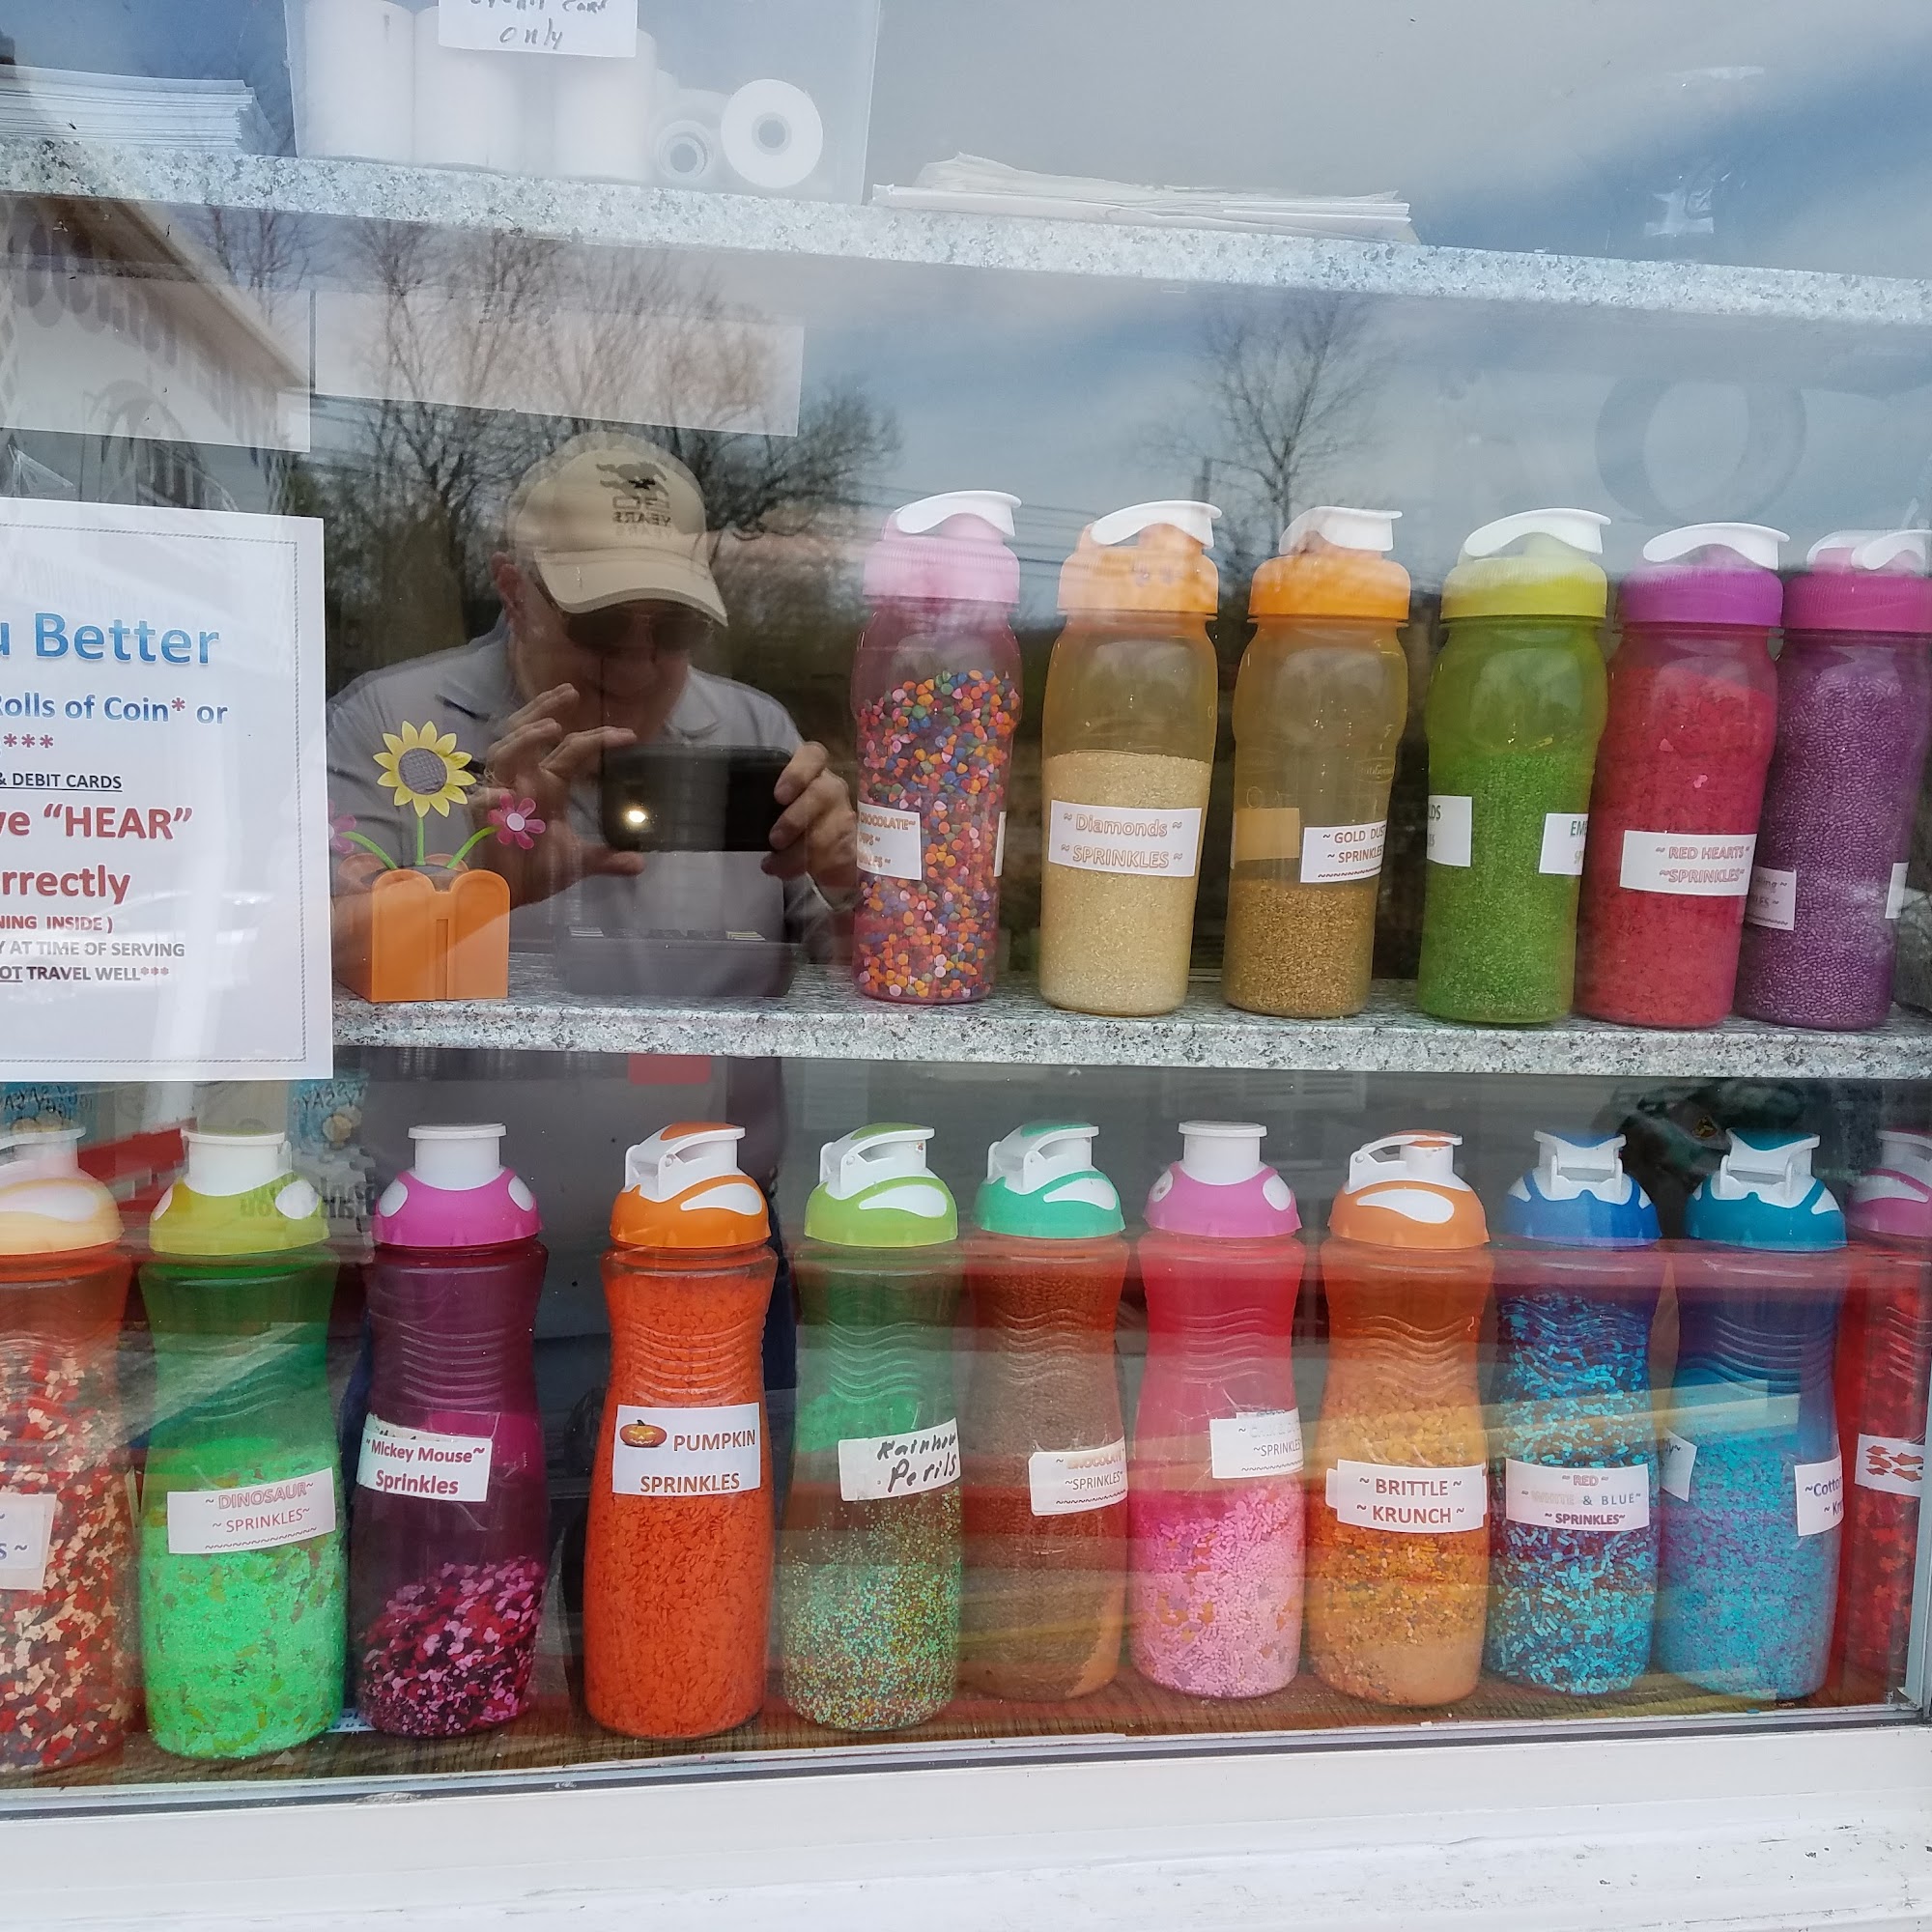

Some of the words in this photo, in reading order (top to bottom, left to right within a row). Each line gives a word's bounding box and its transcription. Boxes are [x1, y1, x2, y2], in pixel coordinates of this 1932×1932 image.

[35, 612, 219, 664] Better
[65, 695, 95, 720] of
[196, 705, 228, 724] or
[13, 773, 61, 788] DEBIT
[67, 774, 122, 789] CARDS
[1076, 814, 1168, 837] Diamonds
[1334, 830, 1366, 843] GOLD
[1073, 844, 1169, 868] SPRINKLES
[1668, 846, 1698, 859] RED
[10, 941, 32, 954] AT
[37, 941, 79, 955] TIME
[84, 942, 106, 955] OF
[111, 943, 185, 956] SERVING
[26, 967, 91, 980] TRAVEL
[673, 1429, 755, 1451] PUMPKIN
[376, 1469, 459, 1494] Sprinkles
[887, 1451, 957, 1493] Perils
[1573, 1474, 1600, 1487] RED
[639, 1472, 740, 1493] SPRINKLES
[1376, 1478, 1448, 1495] BRITTLE
[1582, 1495, 1592, 1505] &
[1373, 1505, 1451, 1524] KRUNCH
